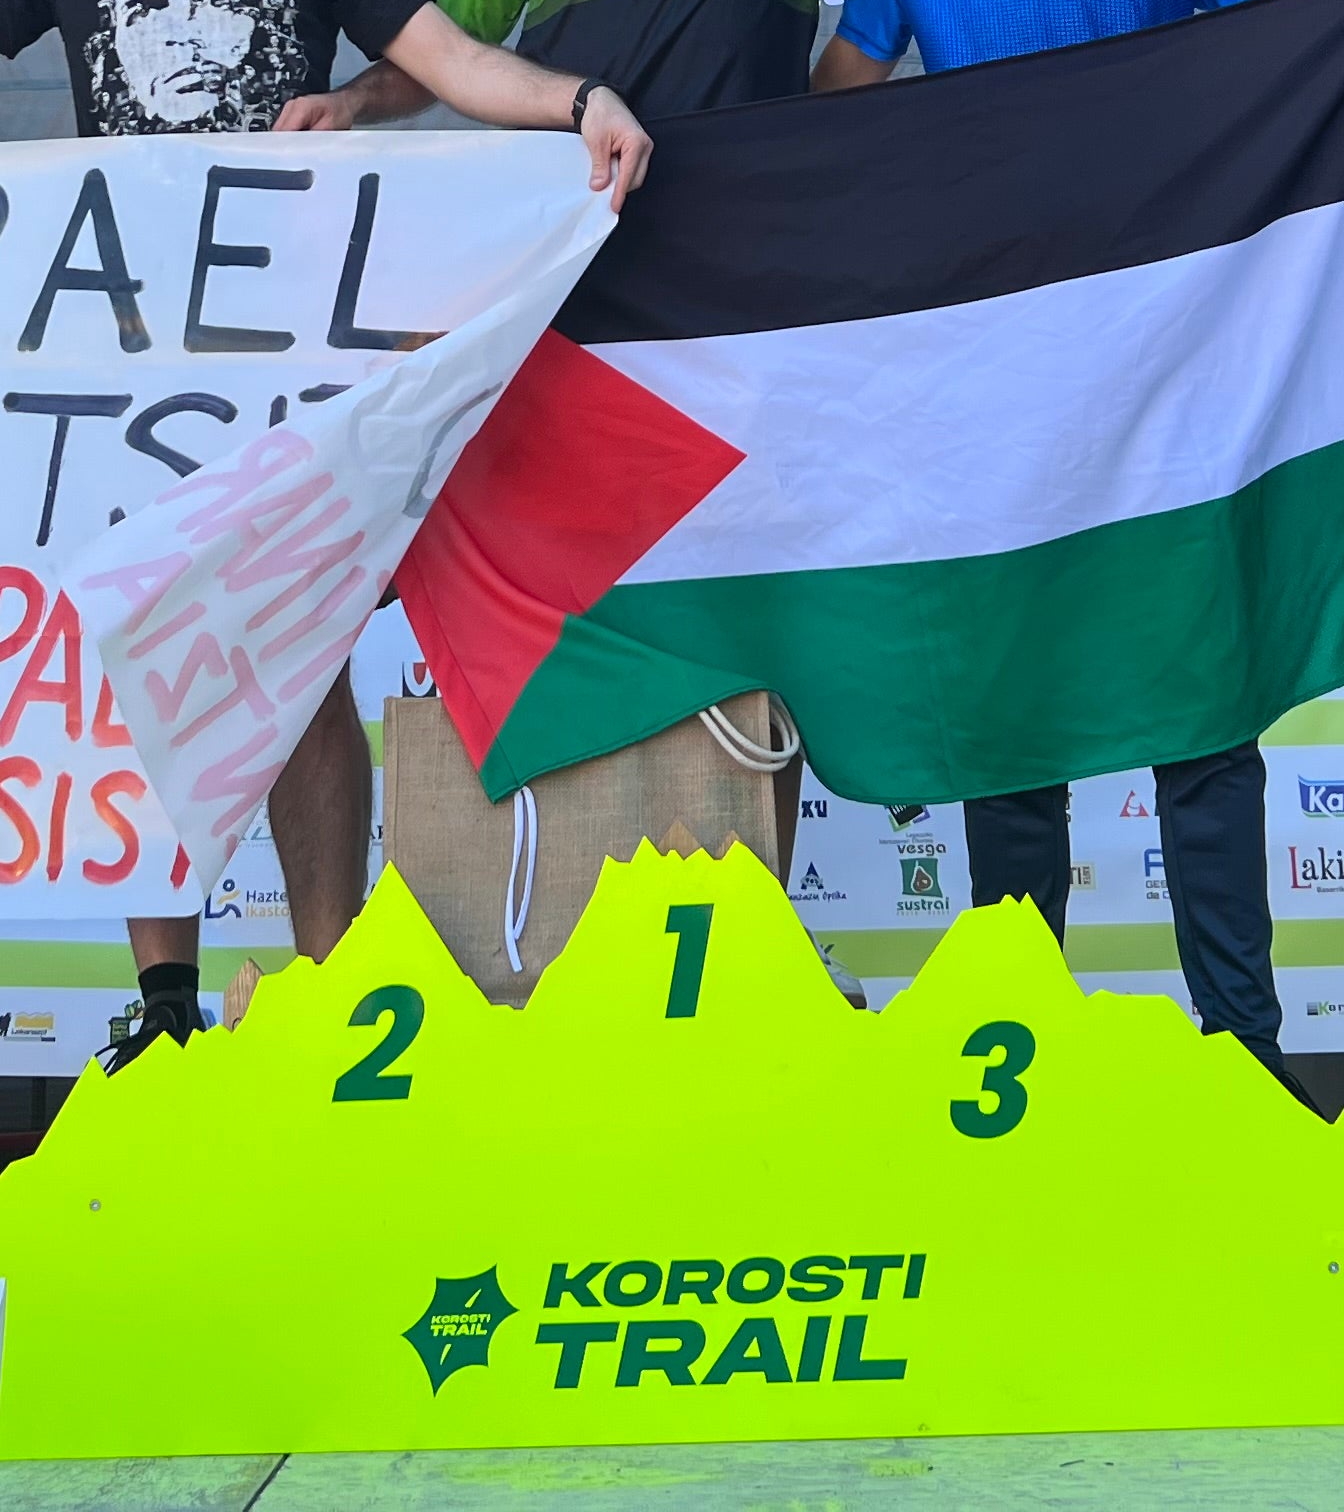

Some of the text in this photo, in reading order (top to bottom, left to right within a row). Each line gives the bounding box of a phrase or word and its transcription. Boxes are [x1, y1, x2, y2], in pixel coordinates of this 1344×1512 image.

[897, 843, 947, 857] vesga
[246, 890, 287, 903] Hazte
[896, 896, 950, 911] sustrai
[664, 903, 714, 1019] 1
[332, 984, 425, 1102] 2
[950, 1020, 1036, 1139] 3
[543, 1253, 927, 1309] KOROSTI
[430, 1323, 488, 1337] TRAIL
[431, 1313, 491, 1325] KOROSTI
[535, 1315, 908, 1390] TRAIL
